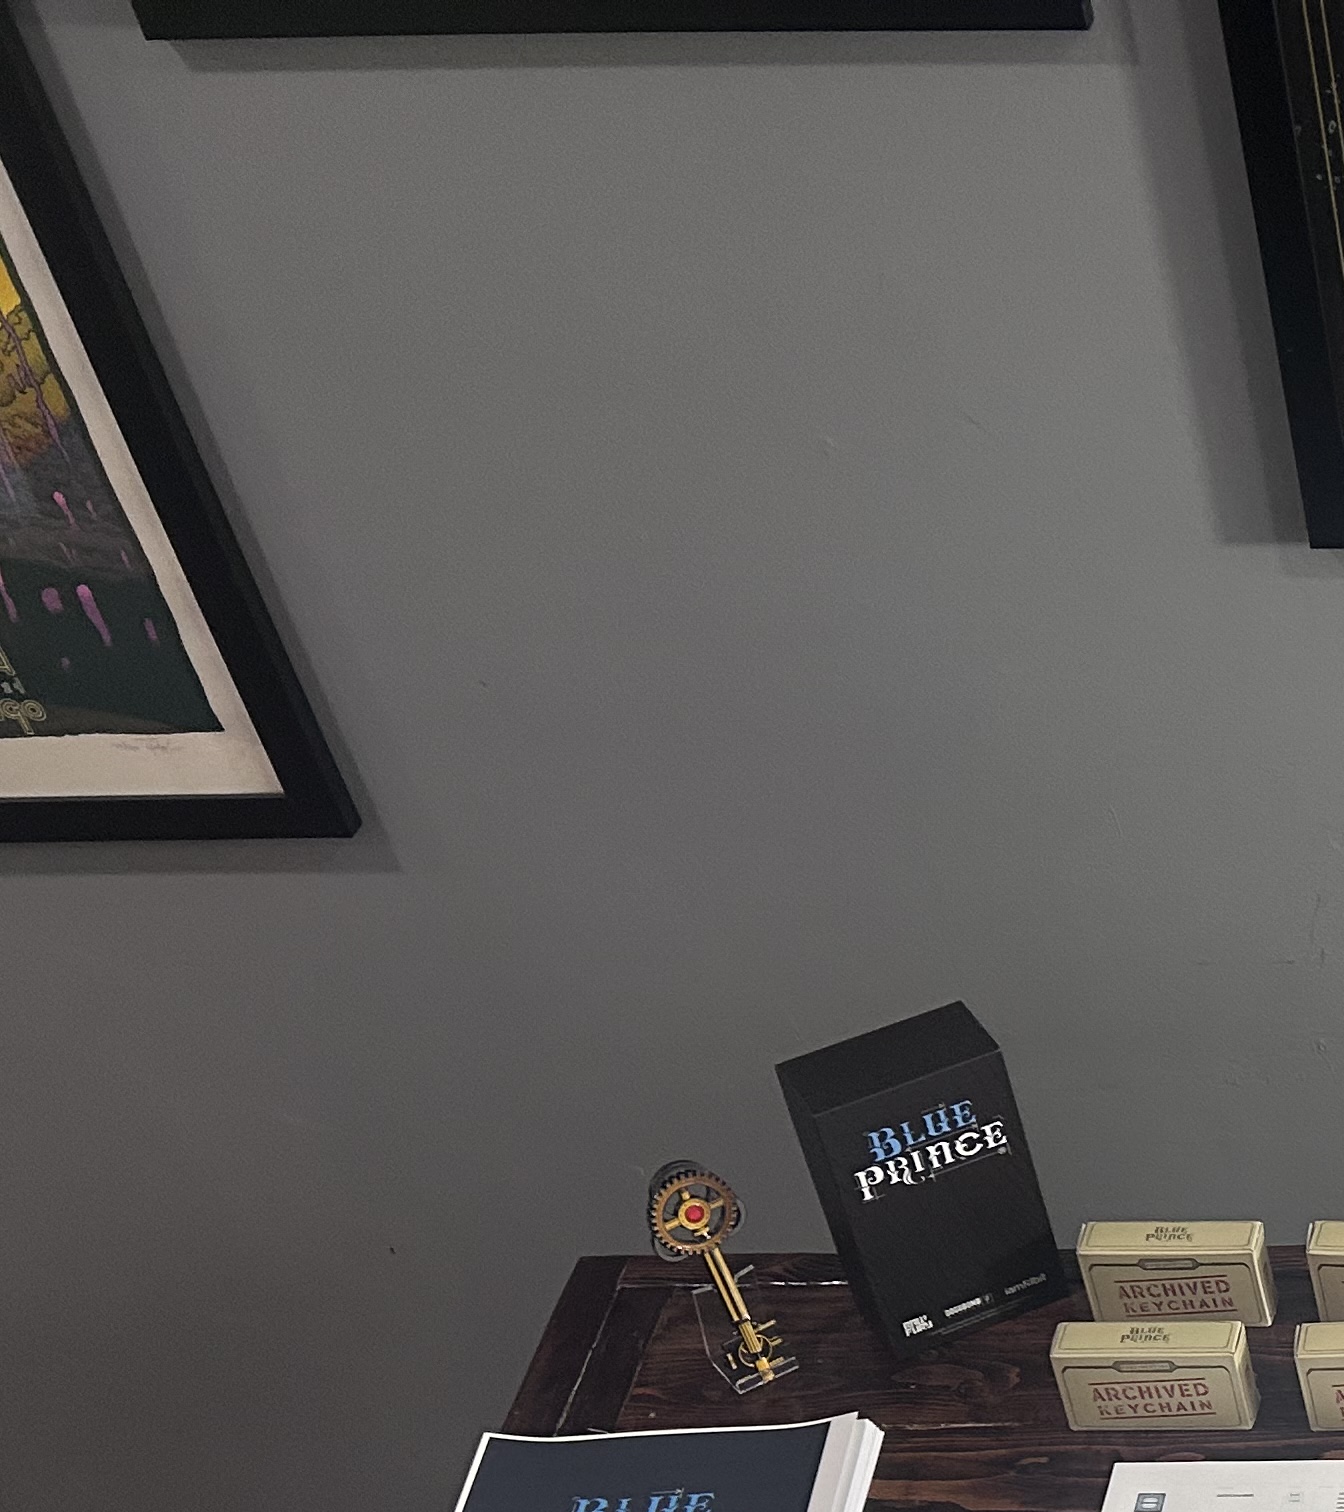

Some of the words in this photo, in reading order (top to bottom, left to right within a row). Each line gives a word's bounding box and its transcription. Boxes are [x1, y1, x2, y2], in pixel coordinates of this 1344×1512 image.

[867, 1100, 977, 1162] BLUE
[853, 1121, 1008, 1201] PRINCE
[1154, 1226, 1188, 1235] BLUE
[1117, 1279, 1230, 1300] ARCHIVED
[1123, 1297, 1235, 1314] KEYCHAIN
[1129, 1326, 1165, 1335] BLUE
[1092, 1382, 1210, 1403] ARCHIVED
[1097, 1399, 1214, 1416] KEYCHAIN
